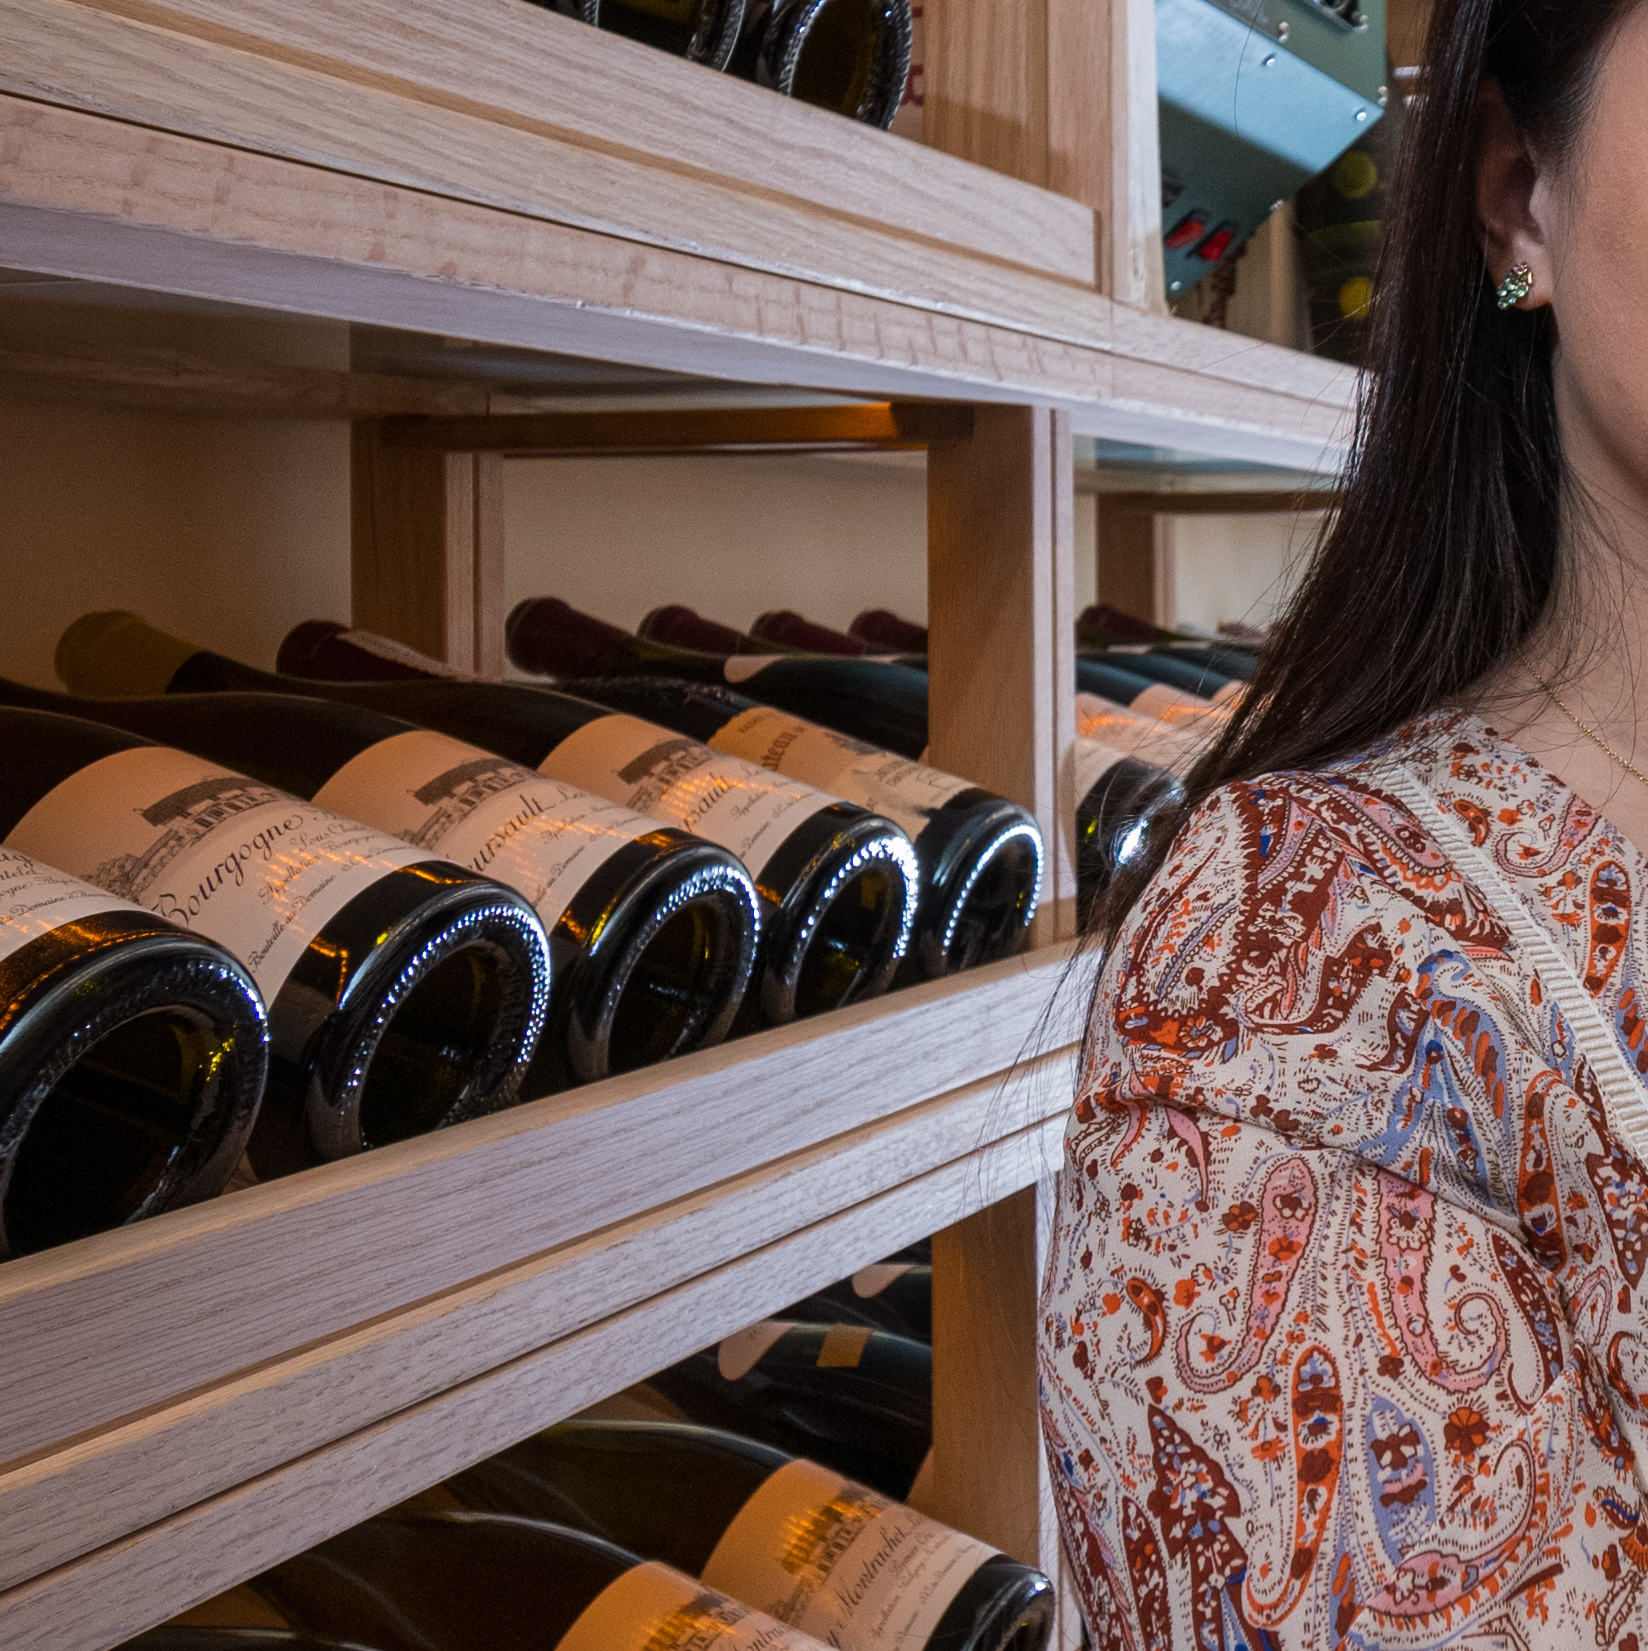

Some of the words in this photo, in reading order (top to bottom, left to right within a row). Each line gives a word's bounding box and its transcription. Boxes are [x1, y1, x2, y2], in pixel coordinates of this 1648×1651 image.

[466, 794, 556, 873] eursault
[151, 813, 304, 926] Bourgogne
[258, 853, 320, 906] Appellation
[291, 873, 337, 916] Domaine
[10, 895, 68, 917] Domaine
